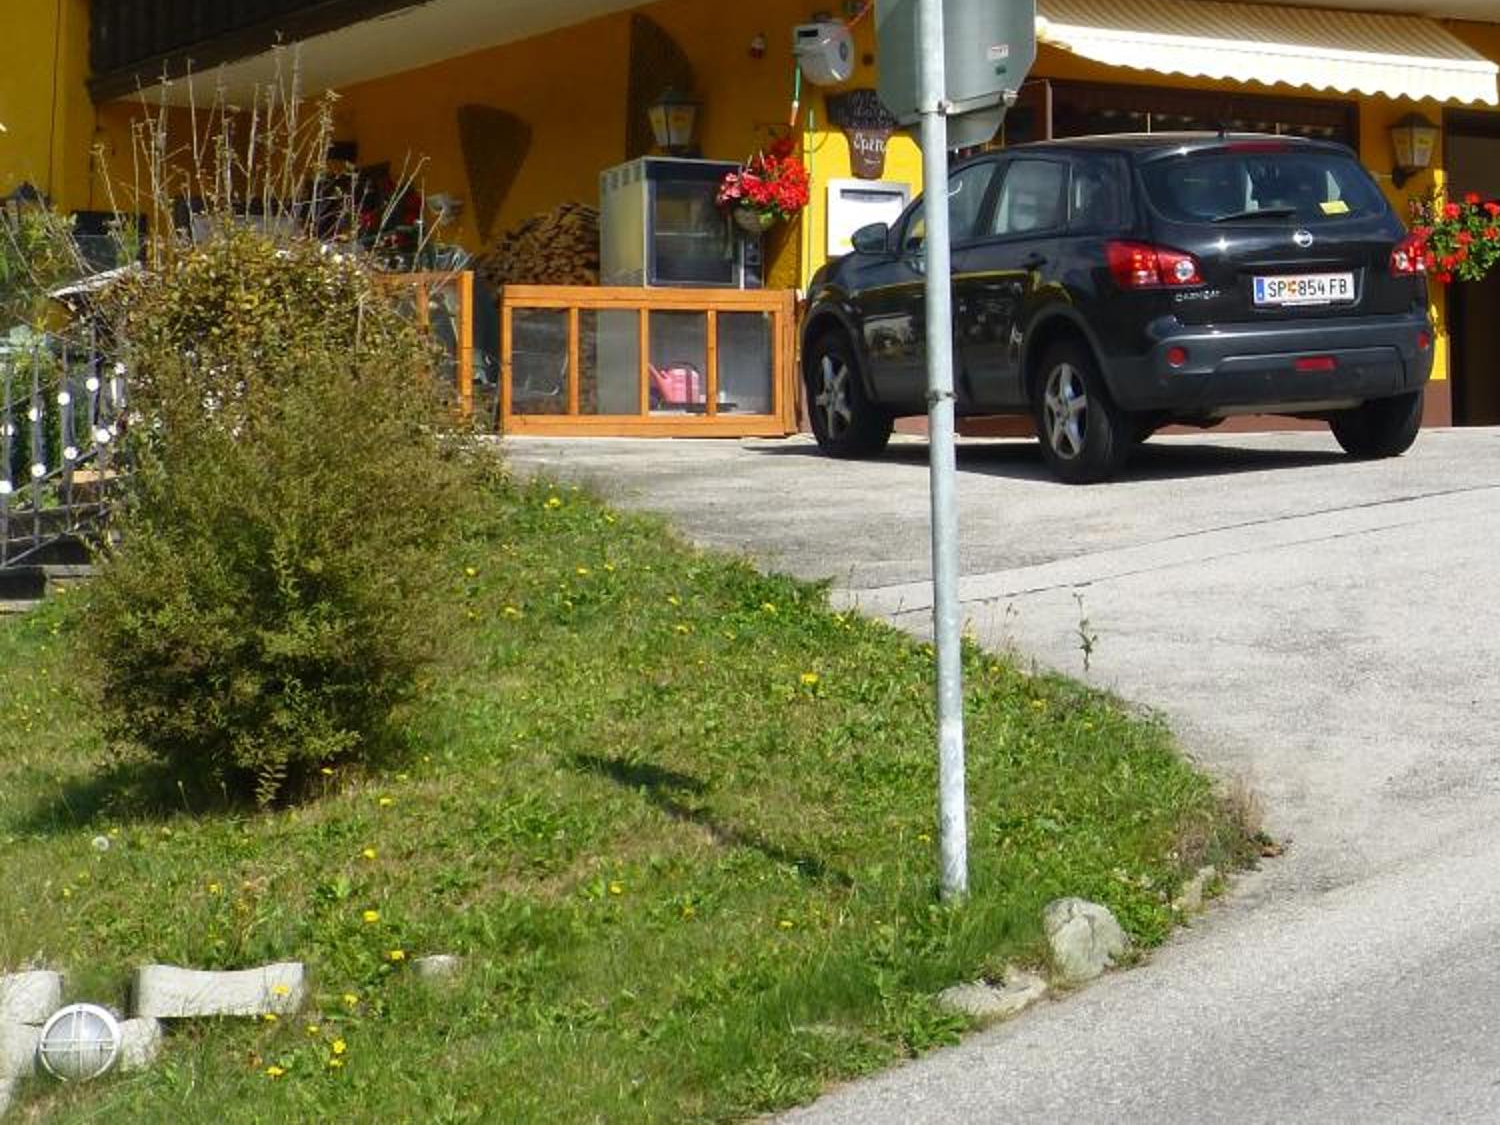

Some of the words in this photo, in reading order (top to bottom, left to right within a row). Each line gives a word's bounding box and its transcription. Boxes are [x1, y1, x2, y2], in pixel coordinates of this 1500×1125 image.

[1267, 281, 1286, 298] SP
[1299, 279, 1325, 296] 854
[1330, 278, 1347, 295] FB
